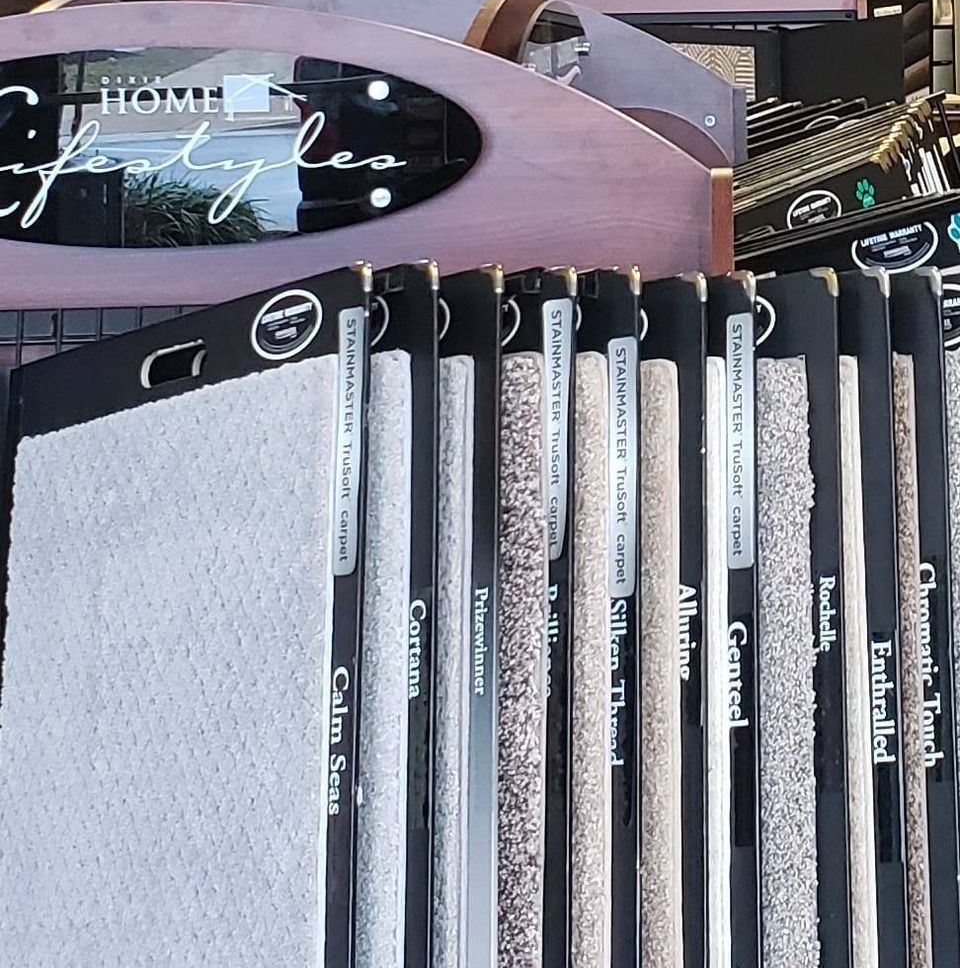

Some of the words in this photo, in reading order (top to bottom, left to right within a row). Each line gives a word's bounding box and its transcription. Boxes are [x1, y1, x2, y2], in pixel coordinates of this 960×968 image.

[100, 87, 219, 115] HOME
[101, 76, 161, 85] DIXIE
[346, 318, 357, 433] STAINMASTER
[551, 309, 562, 422] STAINMASTER
[615, 347, 627, 460] STAINMASTER
[732, 323, 743, 431] STAINMASTER
[341, 442, 353, 499] TruSoft
[550, 429, 561, 485] TruSoft
[732, 440, 743, 496] TruSoft
[616, 468, 627, 524] TruSoft
[732, 506, 742, 557] carpet
[338, 510, 349, 562] carpet
[615, 534, 626, 584] carpet
[408, 598, 427, 700] Cortana
[474, 586, 489, 696] Prizewinner
[610, 599, 628, 672] Silken
[819, 575, 837, 653] Rochelle
[918, 562, 940, 687] Chromatic
[330, 665, 350, 746] Calm
[728, 620, 749, 727] Genteel
[871, 639, 896, 765] Enthralled
[610, 679, 626, 766] Thread
[922, 692, 945, 768] Touch
[328, 753, 346, 816] Seas
